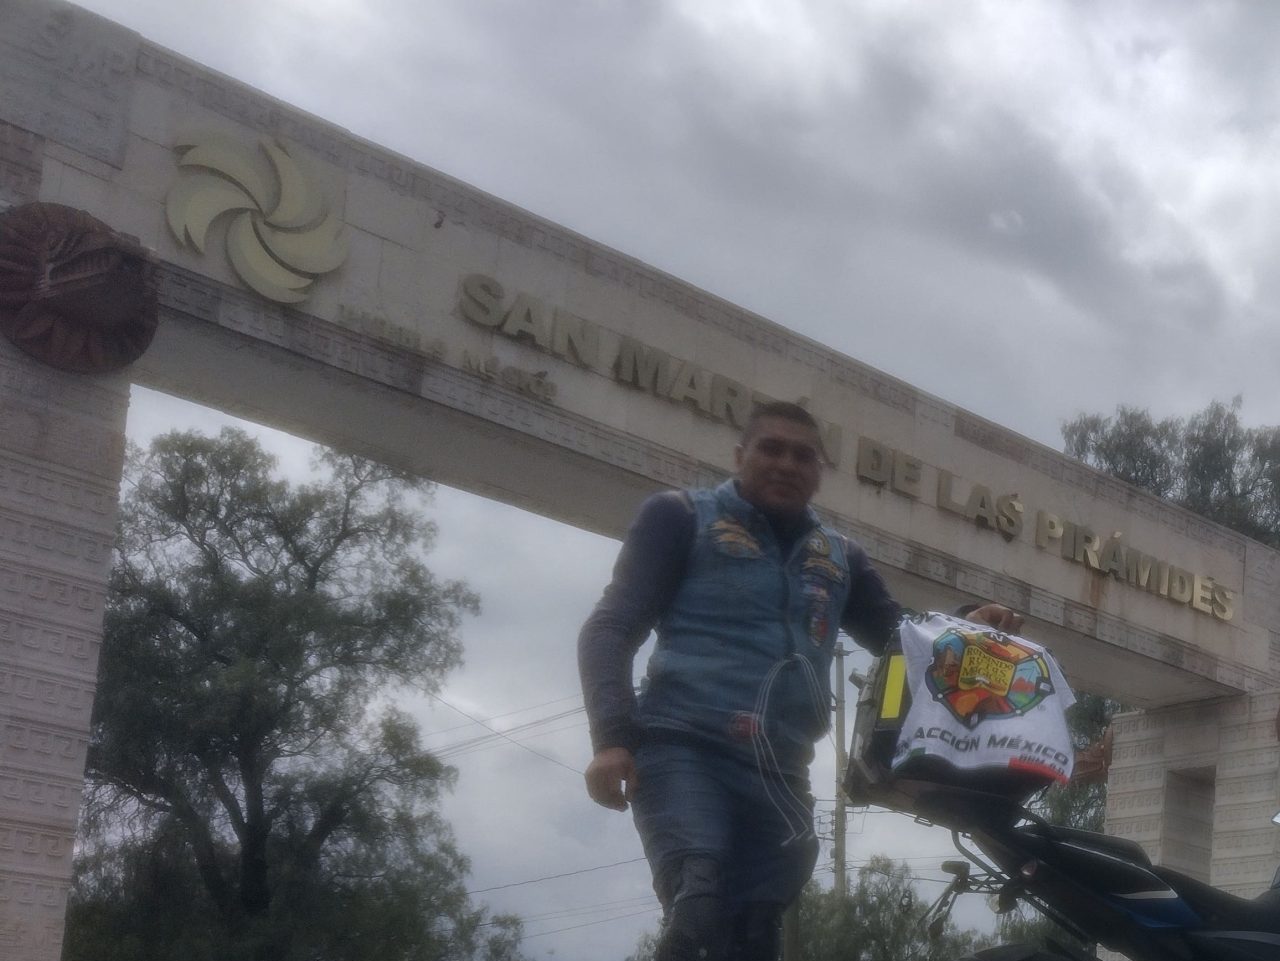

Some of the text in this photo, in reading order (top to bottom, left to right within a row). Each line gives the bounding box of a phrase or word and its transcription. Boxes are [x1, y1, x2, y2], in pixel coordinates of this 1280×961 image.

[459, 273, 597, 370] SAN
[612, 335, 841, 471] MARN
[857, 436, 922, 498] DE
[937, 469, 1024, 541] LAS
[1035, 509, 1235, 621] PIRÁMIDES
[914, 726, 980, 753] ACCIÓN
[987, 733, 1069, 766] MÉXICO
